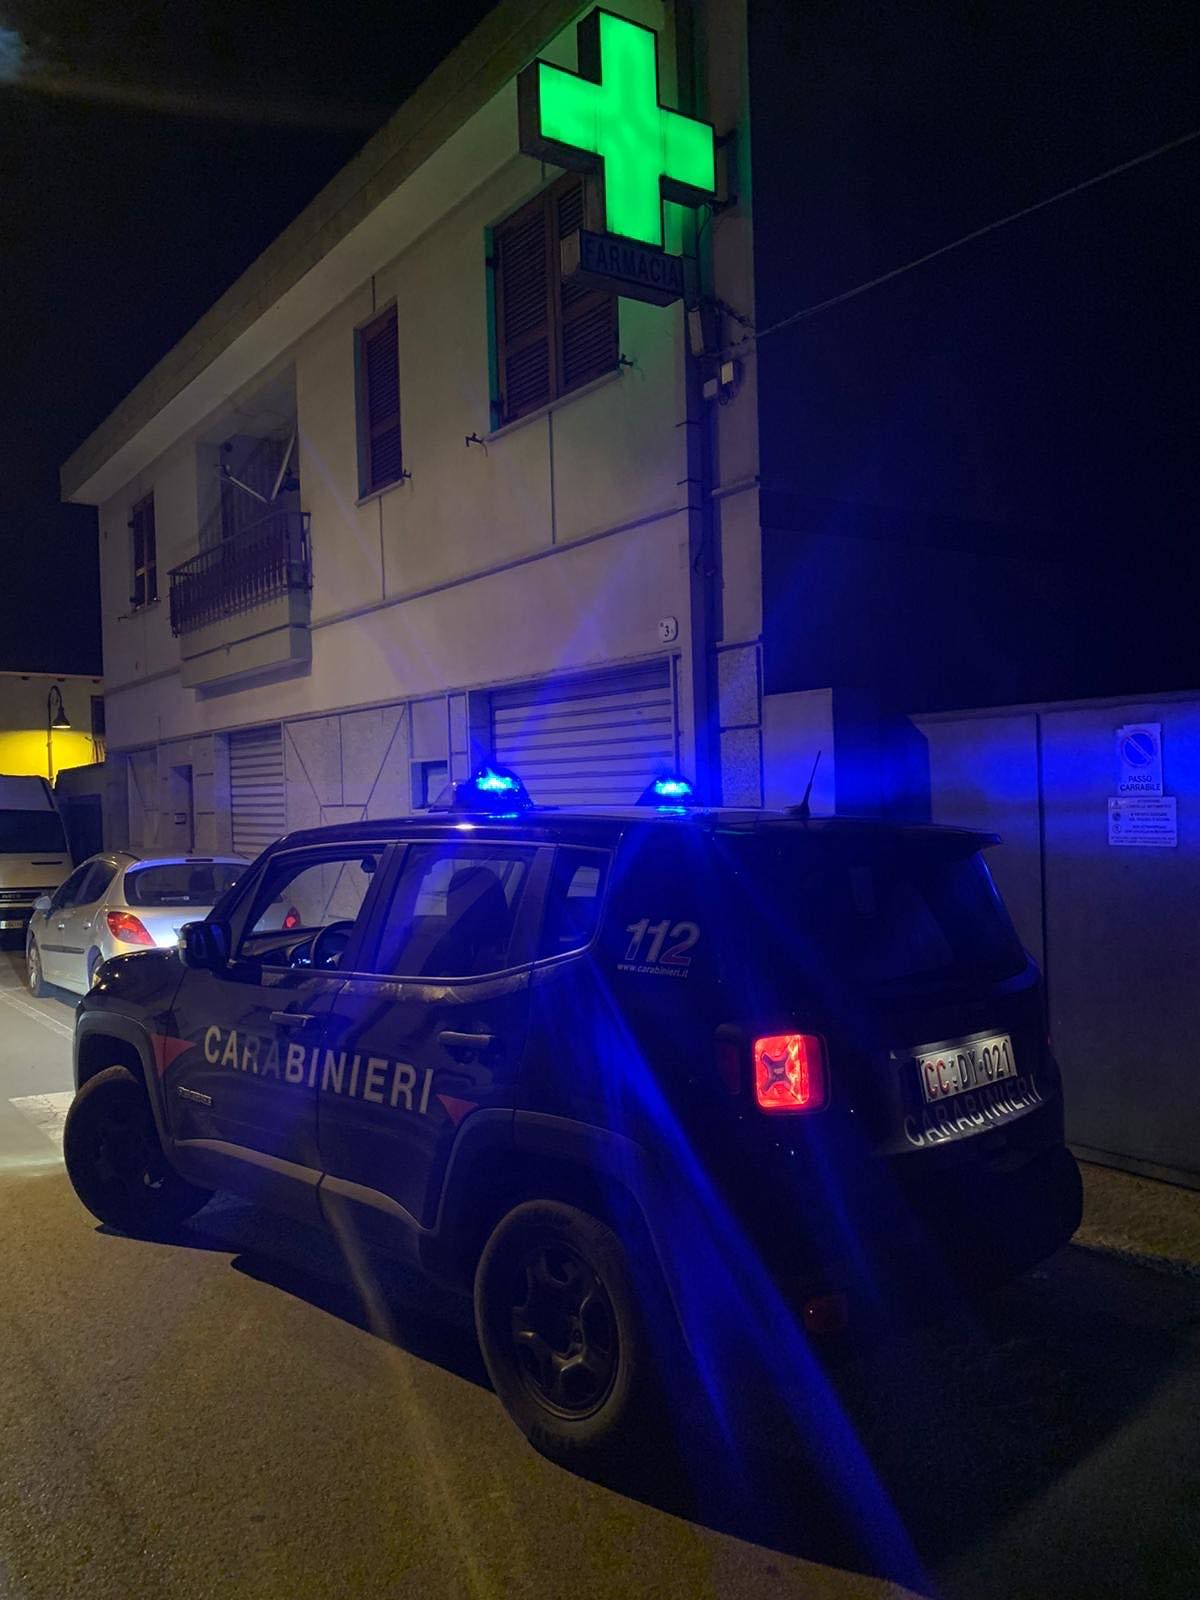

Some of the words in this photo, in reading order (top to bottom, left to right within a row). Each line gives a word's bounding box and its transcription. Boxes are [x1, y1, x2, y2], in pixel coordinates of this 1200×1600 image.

[583, 238, 681, 289] FARMACIA
[1120, 783, 1161, 792] CARRABILE
[1128, 775, 1153, 783] PASSO
[624, 918, 700, 967] 112
[617, 963, 689, 978] www.carabinieri.it
[204, 1025, 434, 1115] CARABINIERI
[904, 1073, 1043, 1147] CARABINIERI
